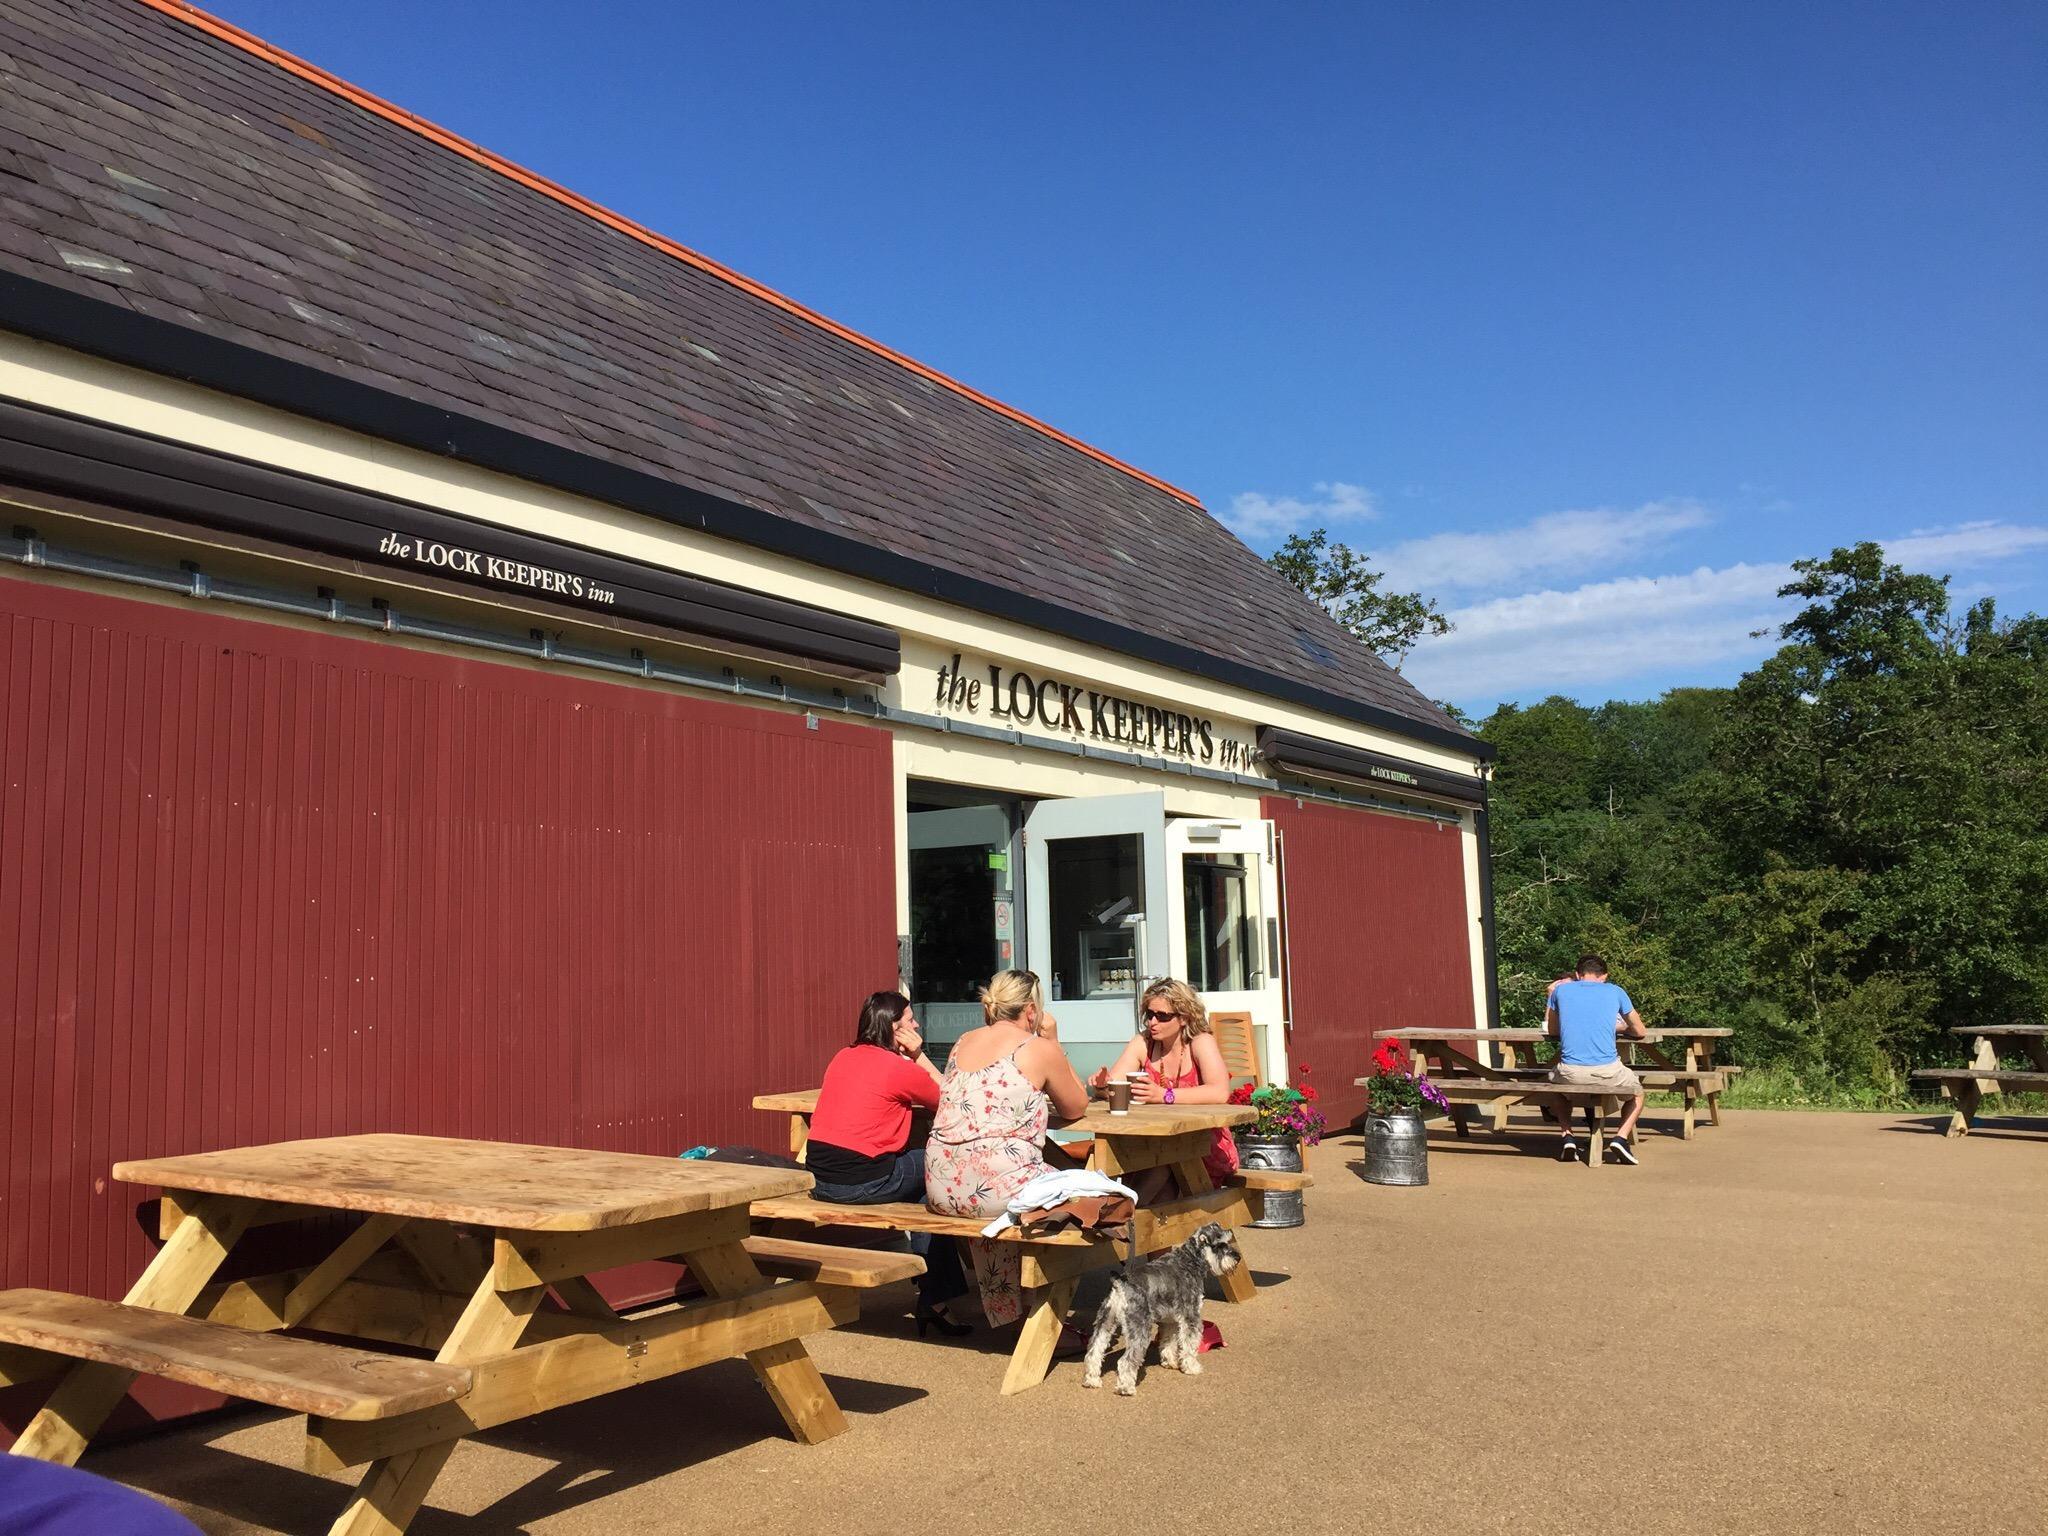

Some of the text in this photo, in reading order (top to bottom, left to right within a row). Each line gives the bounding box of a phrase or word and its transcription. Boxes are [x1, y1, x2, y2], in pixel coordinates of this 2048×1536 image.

[379, 533, 615, 605] the LOCK KEEPER'S inn
[936, 654, 982, 710] the
[987, 664, 1086, 732] LOCK
[1088, 690, 1215, 760] KEEPER'S
